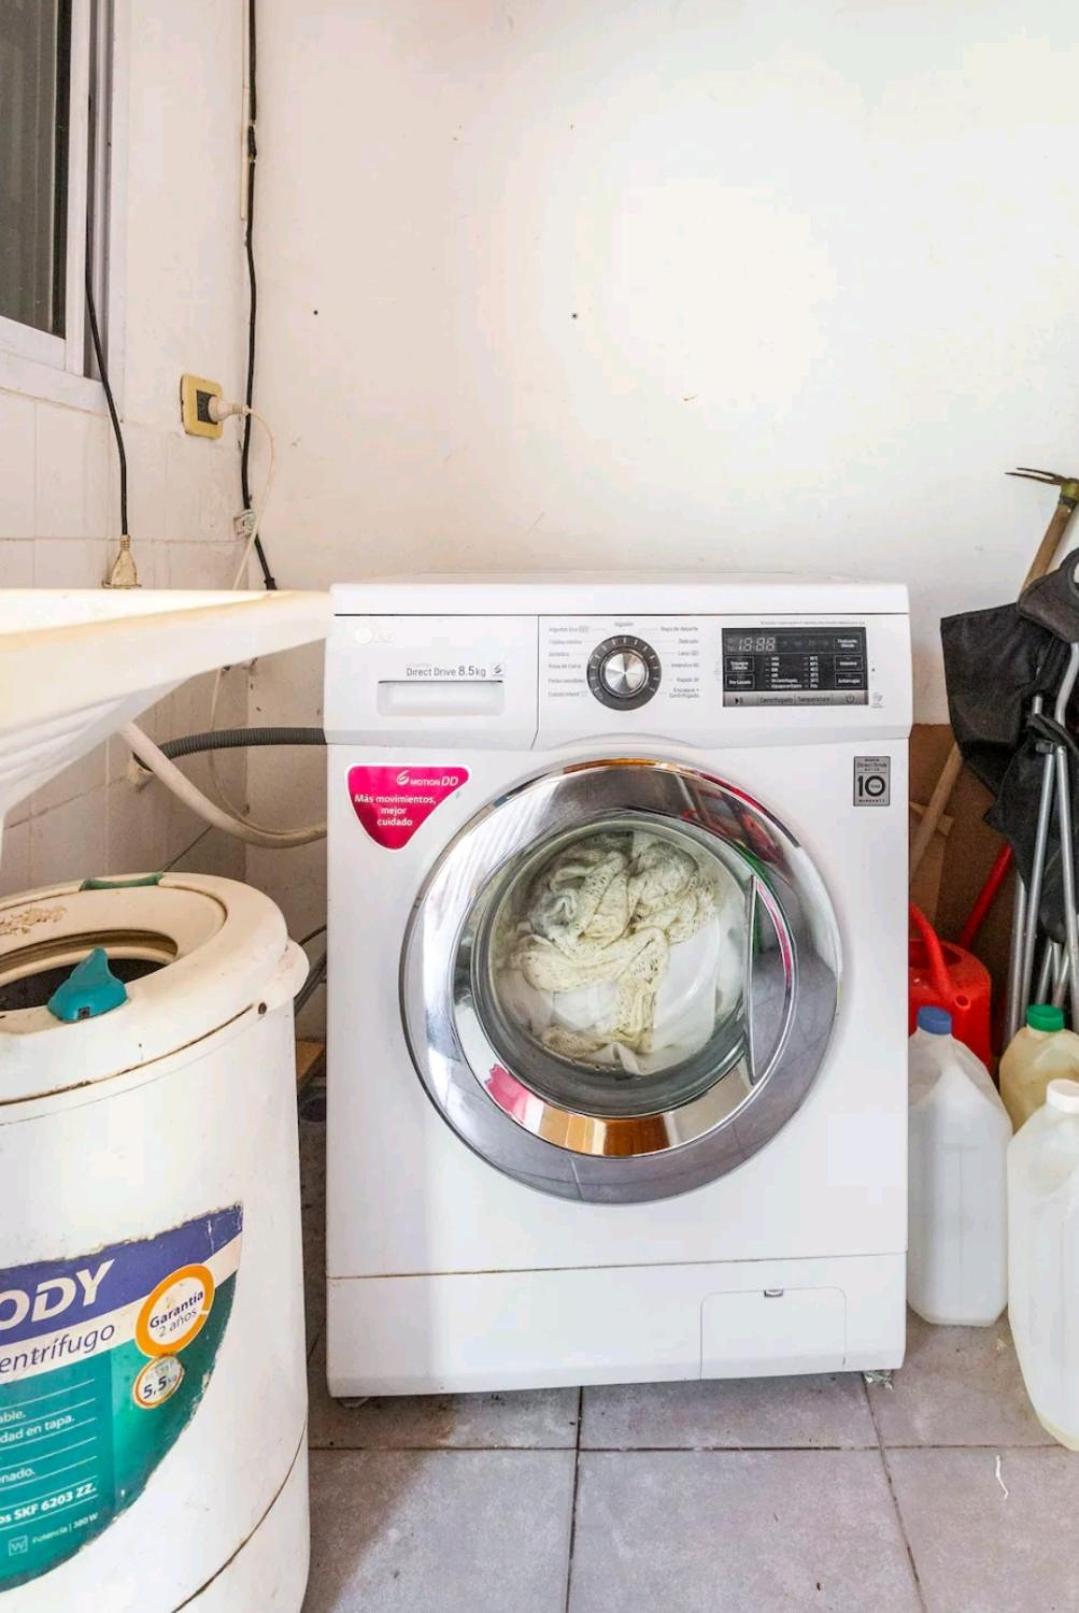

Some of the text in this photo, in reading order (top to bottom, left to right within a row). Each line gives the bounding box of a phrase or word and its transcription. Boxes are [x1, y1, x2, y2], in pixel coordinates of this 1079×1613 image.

[406, 667, 432, 677] Direct
[433, 667, 456, 677] Drive
[857, 775, 886, 797] 10
[354, 793, 436, 805] Más movimientos,
[381, 807, 407, 816] mejor
[377, 817, 413, 827] cuidado
[158, 1326, 166, 1338] 2
[26, 1425, 42, 1437] en
[44, 1415, 75, 1431] tapa.
[13, 1503, 39, 1520] SKF
[41, 1491, 73, 1511] 6203
[76, 1482, 97, 1498] ZZ.
